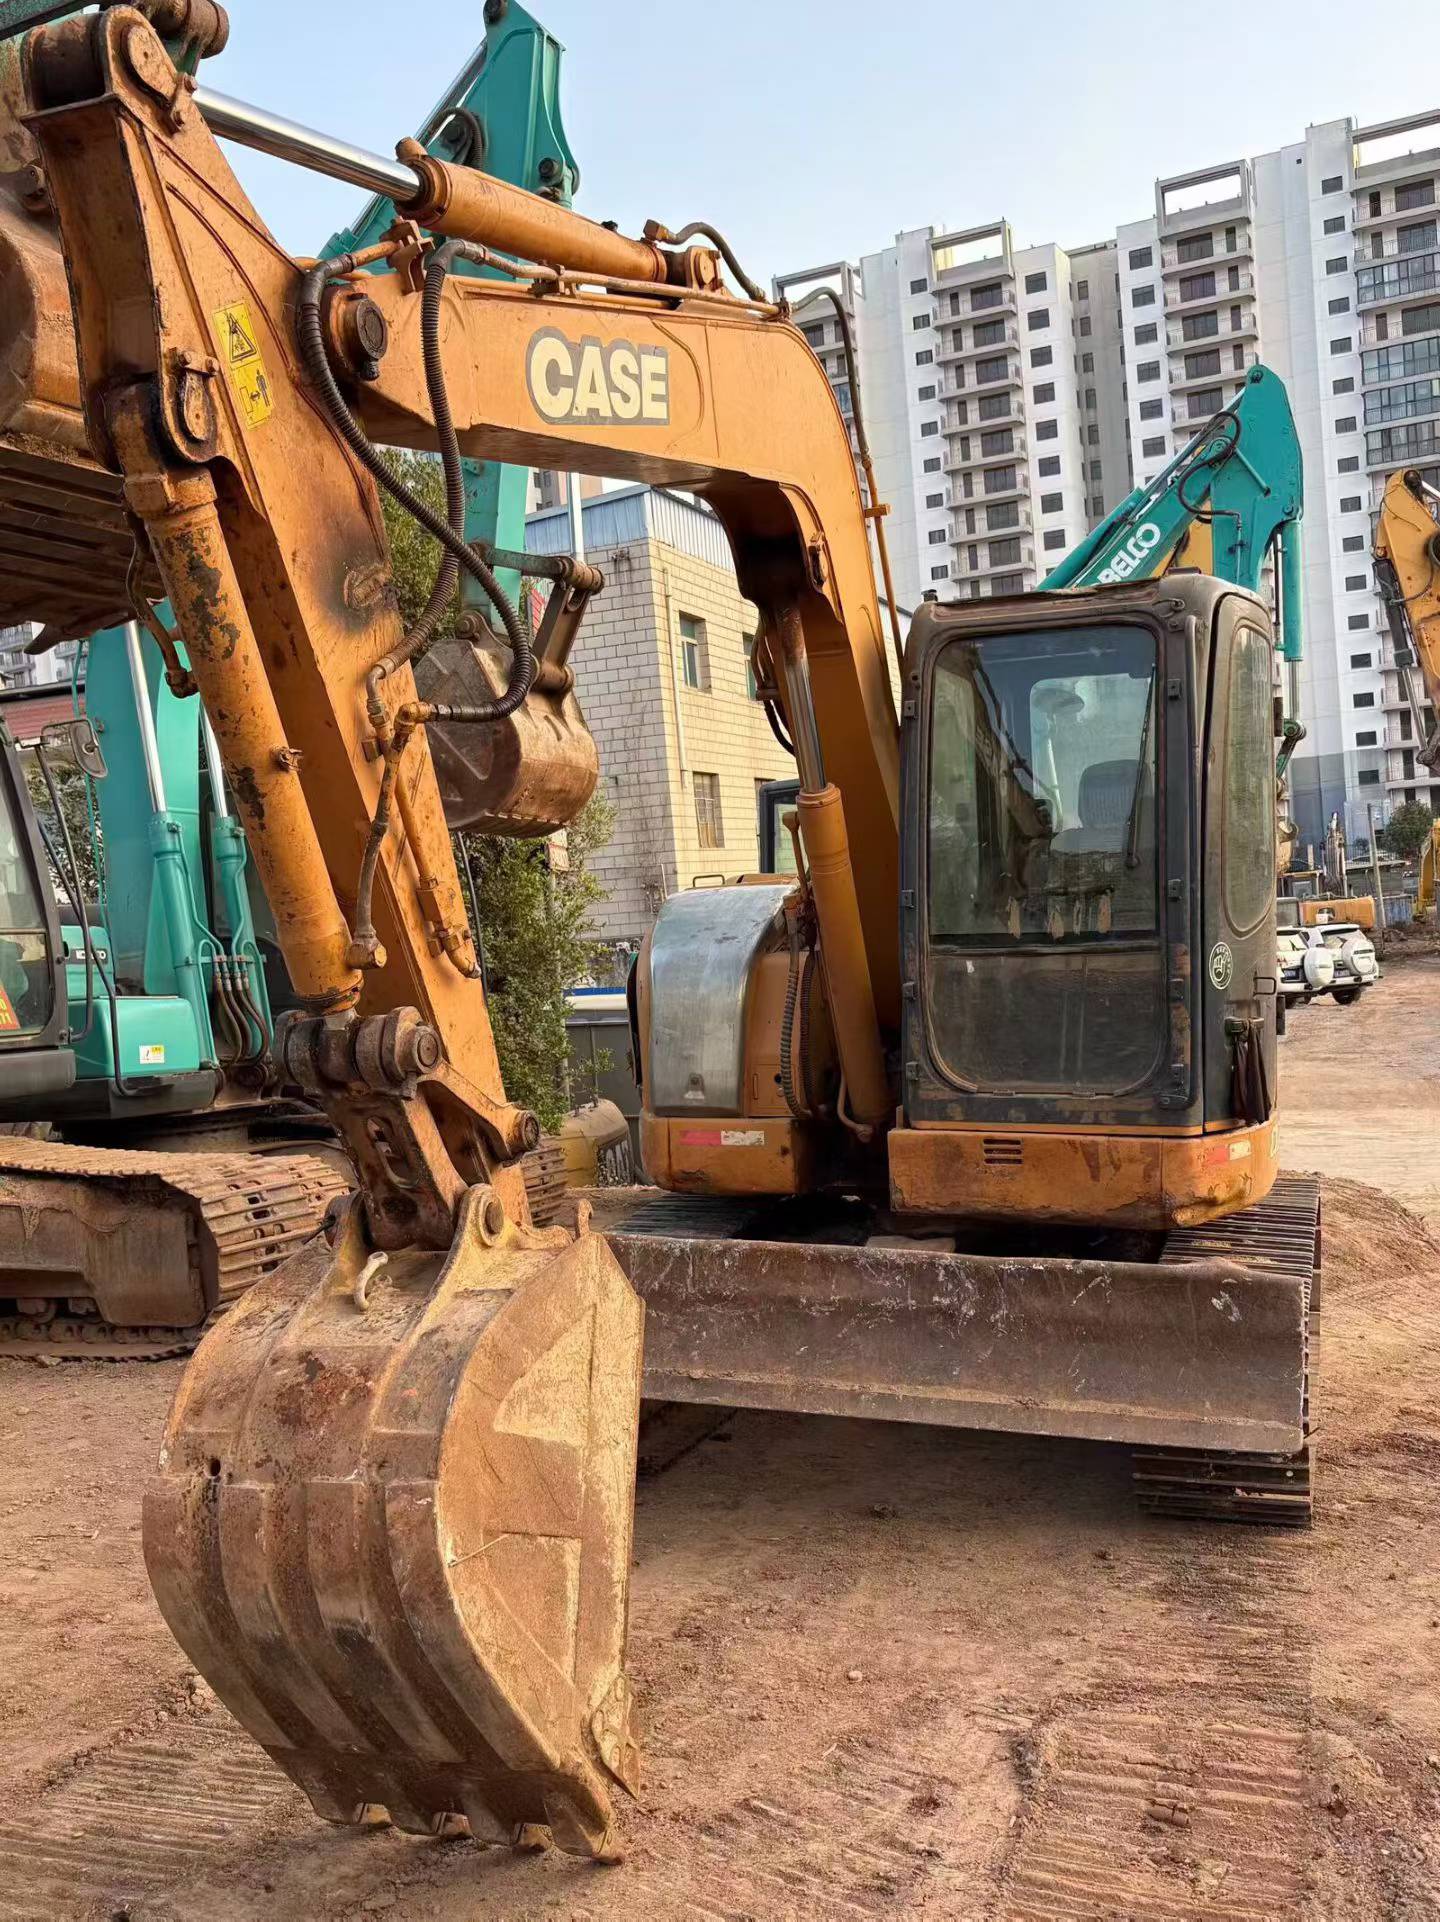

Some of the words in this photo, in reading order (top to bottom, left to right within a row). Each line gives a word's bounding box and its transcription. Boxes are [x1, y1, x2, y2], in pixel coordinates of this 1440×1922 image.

[530, 336, 668, 419] CASE
[1094, 522, 1161, 584] BELCO
[75, 950, 107, 960] KOCO
